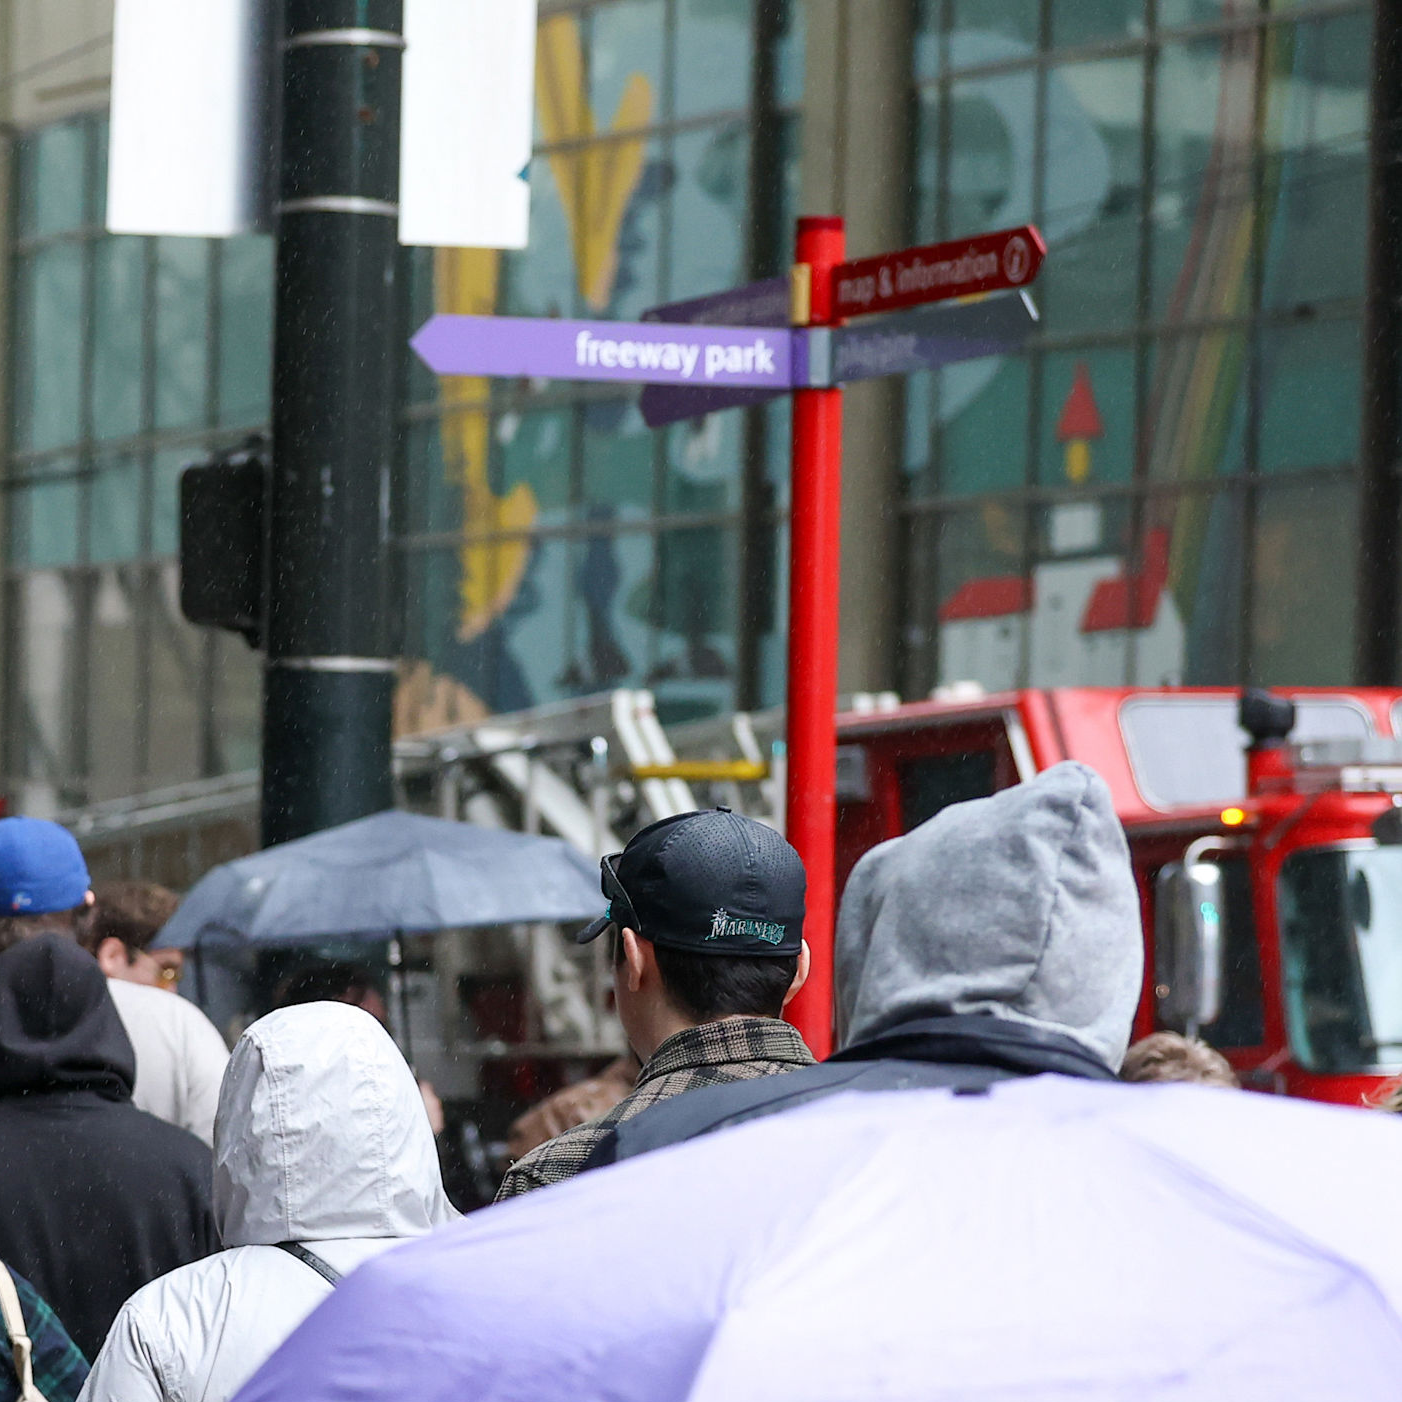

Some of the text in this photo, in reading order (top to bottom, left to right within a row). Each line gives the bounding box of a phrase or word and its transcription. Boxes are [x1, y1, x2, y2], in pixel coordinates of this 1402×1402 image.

[897, 248, 997, 293] information
[576, 330, 775, 379] freeway park
[711, 920, 785, 943] MARINERS
